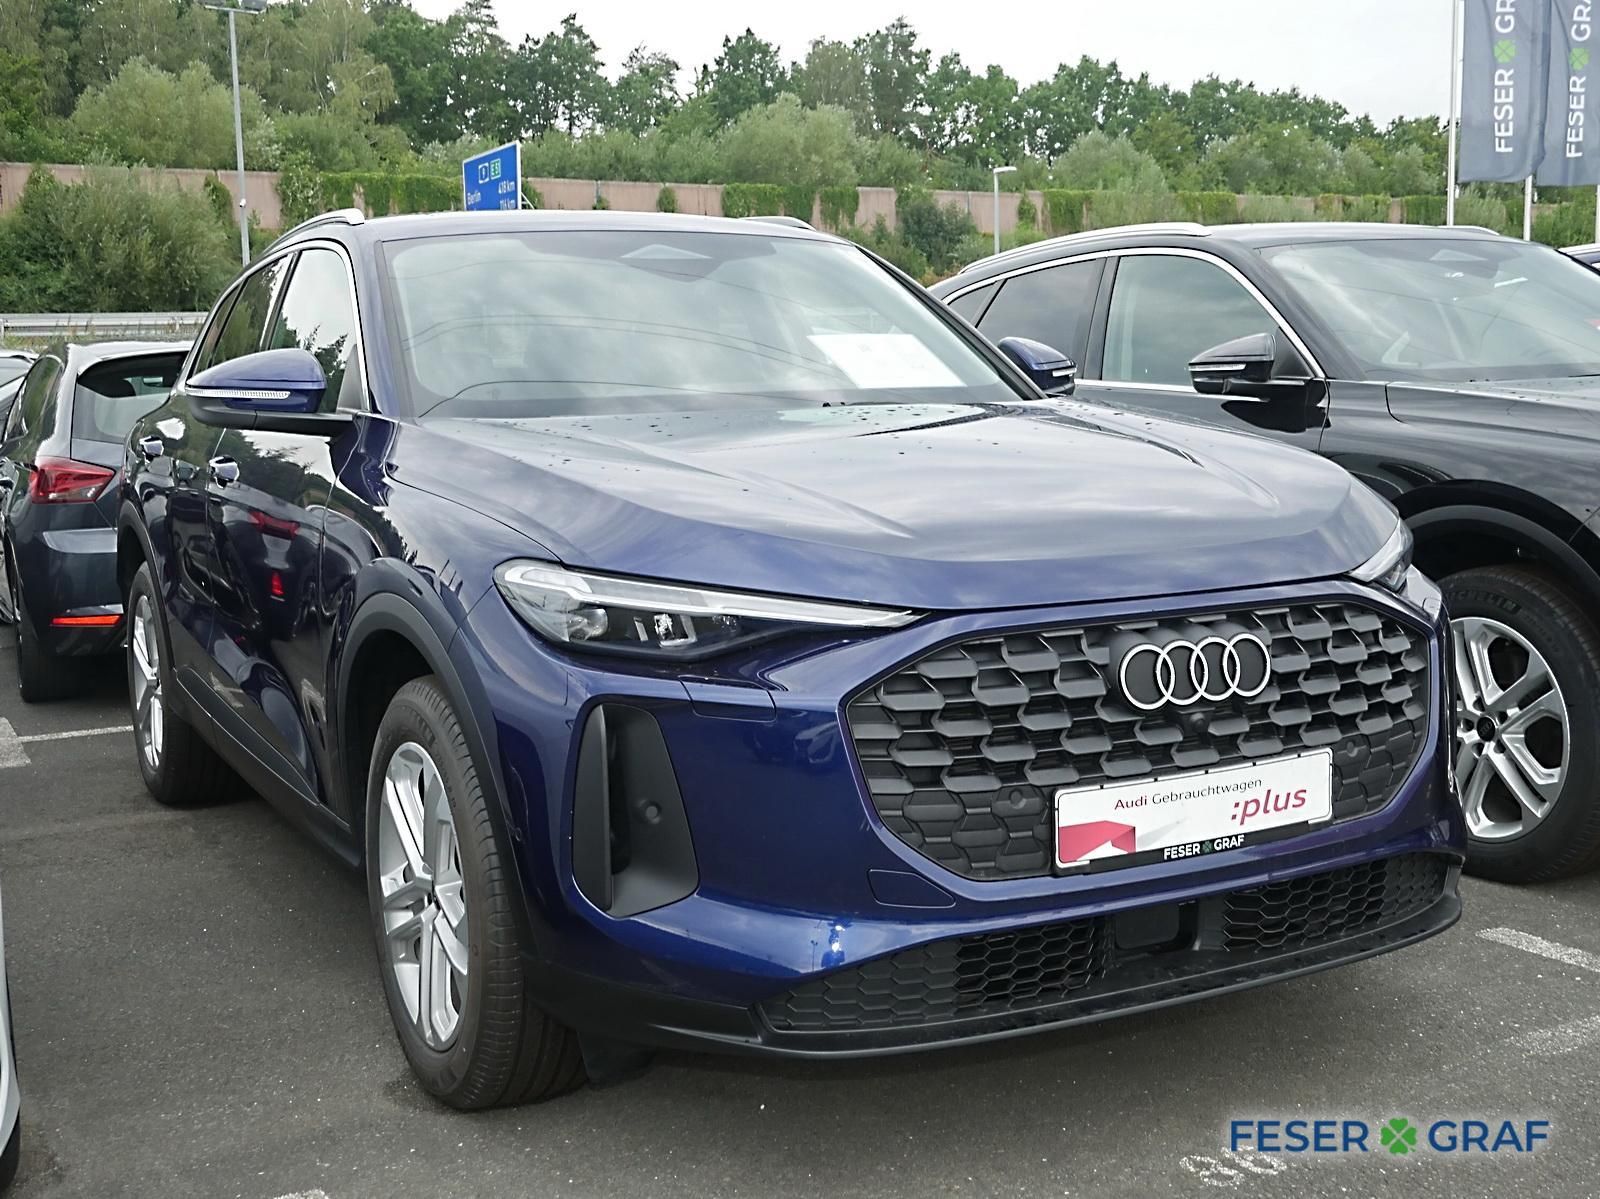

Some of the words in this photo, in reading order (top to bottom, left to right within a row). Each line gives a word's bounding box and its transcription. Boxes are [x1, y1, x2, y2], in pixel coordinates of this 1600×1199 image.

[1494, 68, 1514, 152] FESER
[1566, 76, 1586, 158] FESER
[1114, 795, 1148, 811] Audi
[1152, 777, 1262, 805] Gebrauchtwagen
[1163, 843, 1201, 860] FESER
[1214, 834, 1245, 851] GRAF
